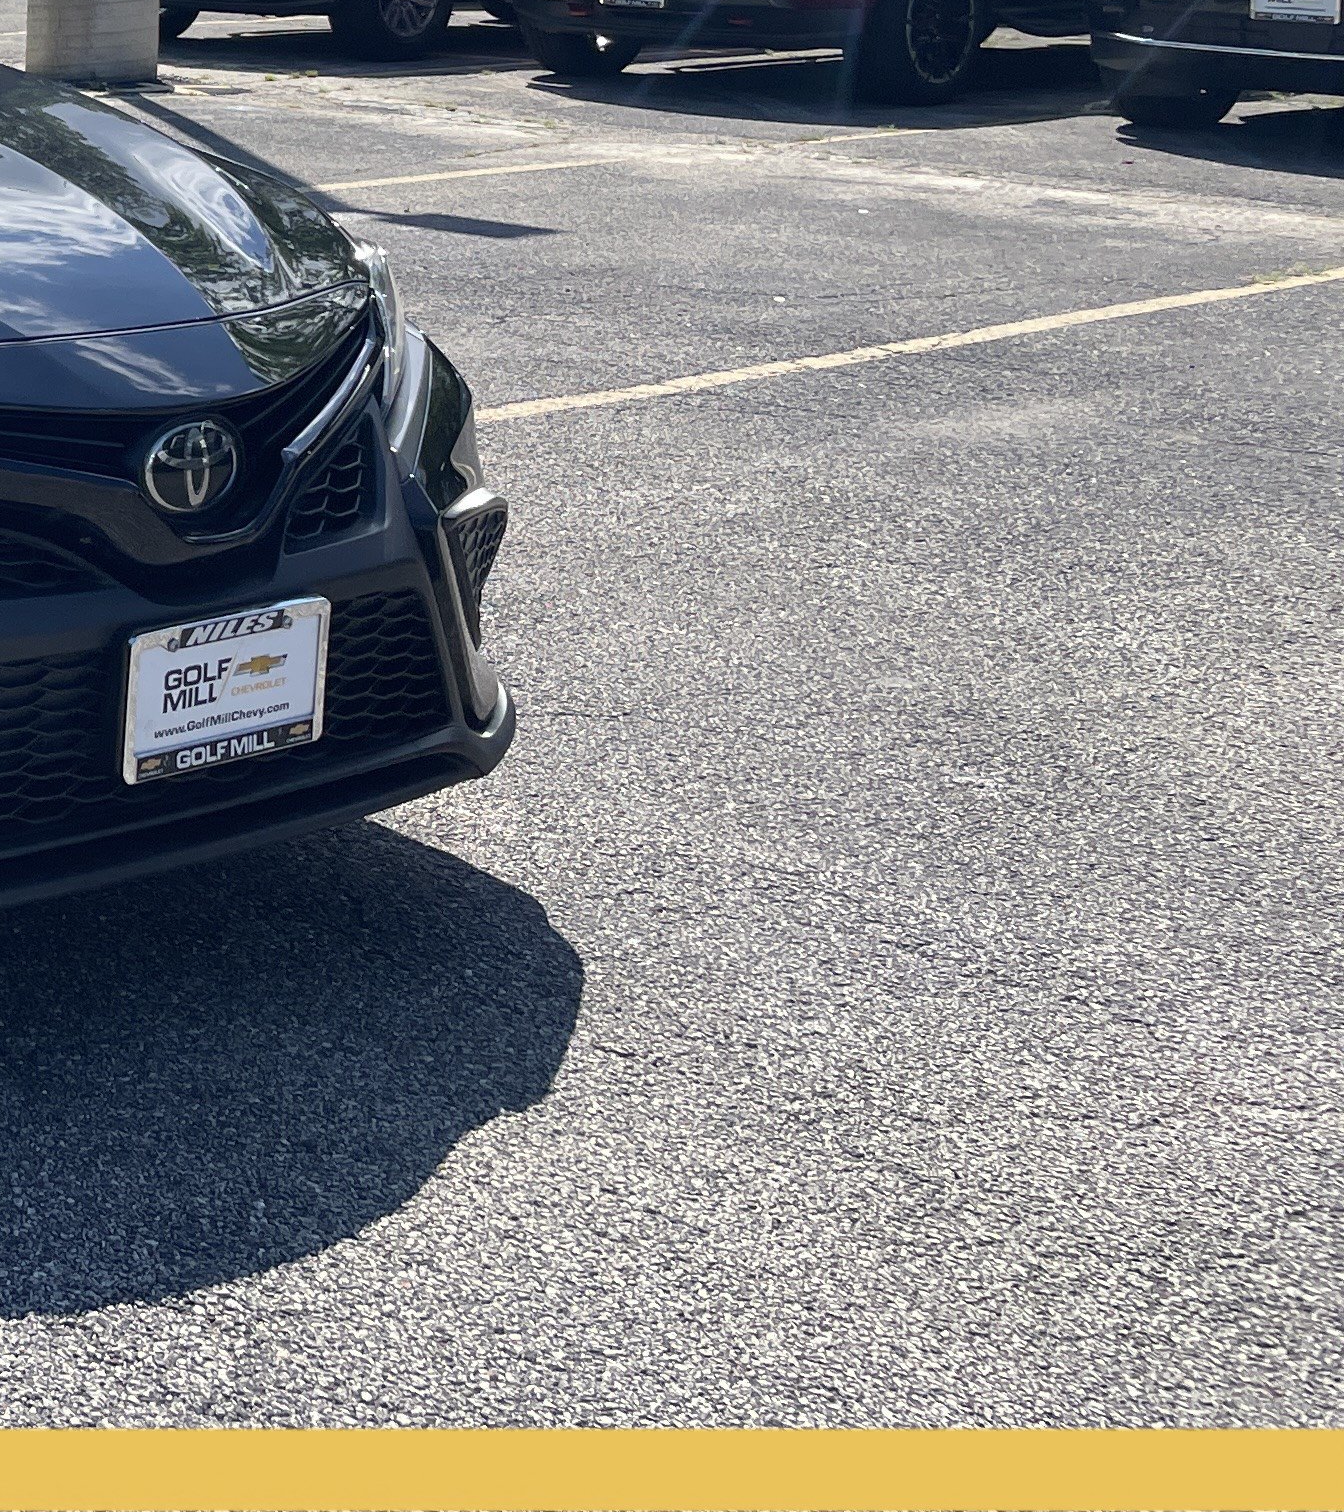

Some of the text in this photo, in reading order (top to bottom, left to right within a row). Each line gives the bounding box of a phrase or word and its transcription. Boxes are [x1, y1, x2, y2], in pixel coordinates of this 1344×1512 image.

[185, 611, 279, 646] NILES
[164, 657, 233, 691] GOLF
[230, 676, 288, 697] CHEVROLET
[162, 683, 217, 714] MILL
[154, 702, 290, 739] www.GolfMillChevy.com
[175, 731, 275, 769] GOLF MILL
